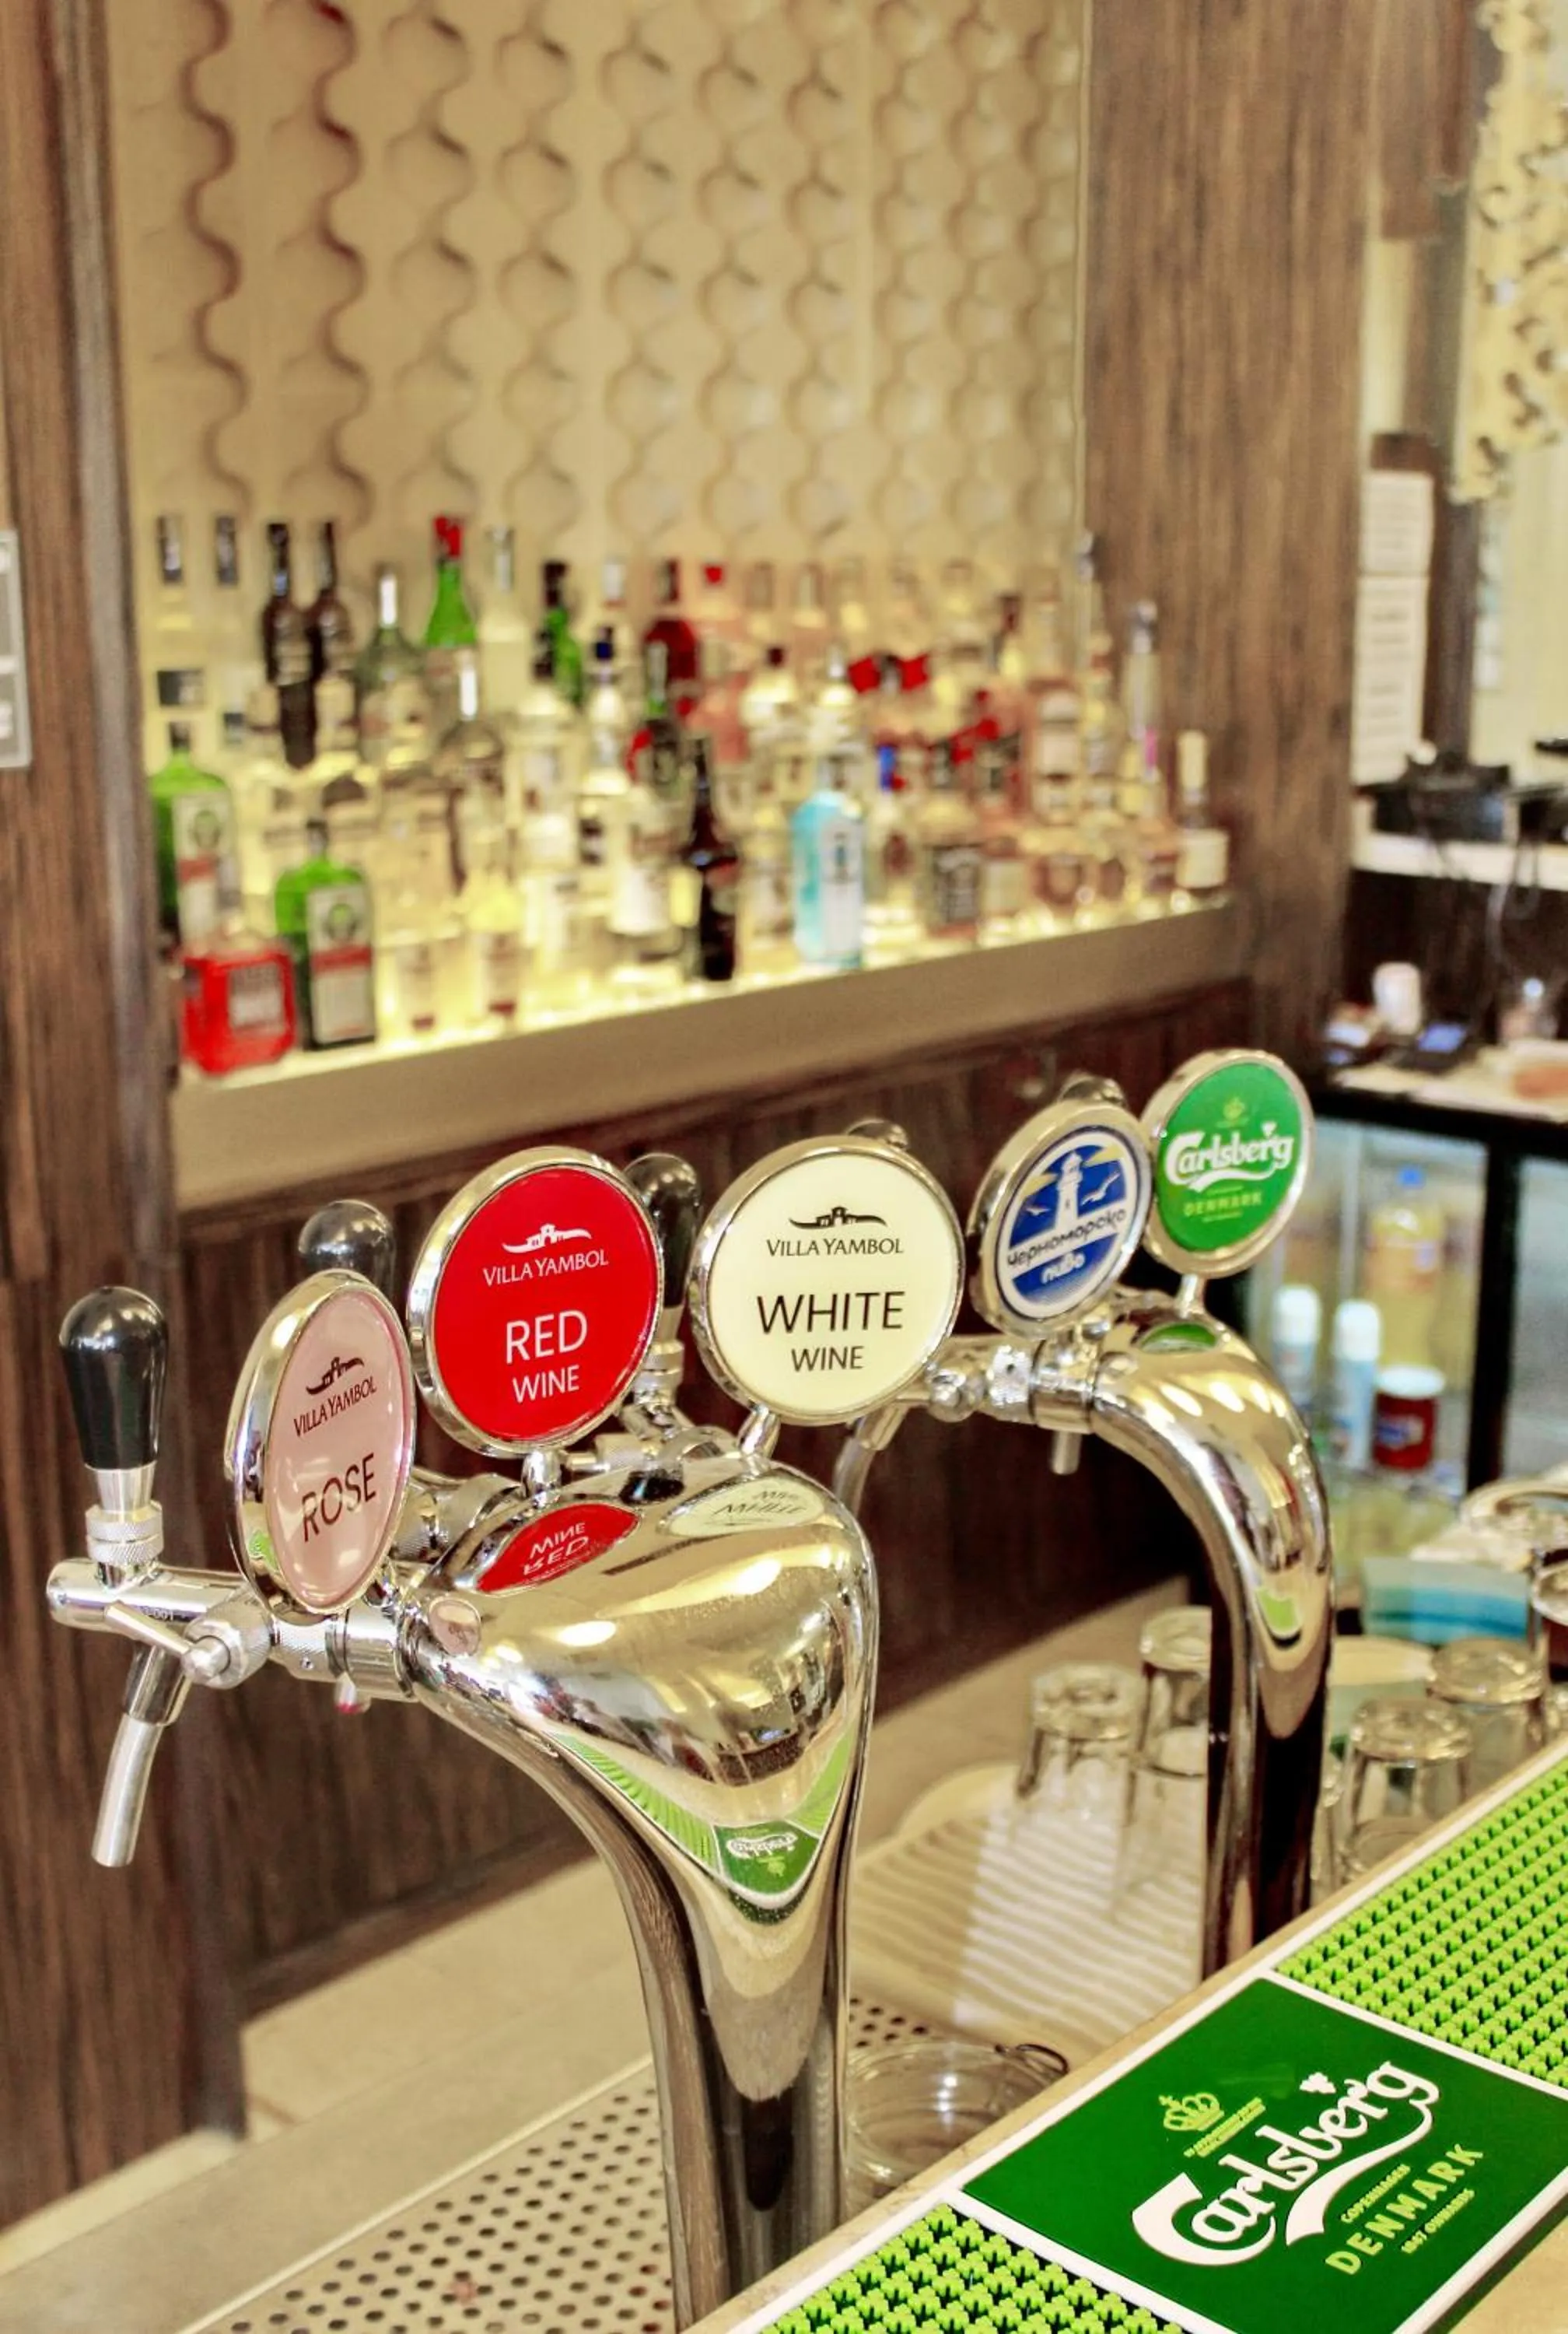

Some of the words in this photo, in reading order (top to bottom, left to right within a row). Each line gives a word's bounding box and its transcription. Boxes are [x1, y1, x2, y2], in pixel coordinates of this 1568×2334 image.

[1164, 1127, 1294, 1191] Carlsberg
[482, 1262, 534, 1287] VILLA
[535, 1249, 609, 1277] YAMBOL
[766, 1239, 820, 1256] VILLA
[823, 1238, 904, 1256] YAMBOL
[506, 1309, 588, 1365] RED
[757, 1291, 905, 1335] WHITE
[513, 1364, 579, 1404] WINE
[791, 1345, 864, 1372] WINE
[293, 1404, 328, 1437] VILLA
[327, 1376, 377, 1417] YAMBOL
[302, 1453, 376, 1542] ROSE
[1132, 2060, 1440, 2266] Carlsberg
[1325, 2143, 1484, 2275] DENMARK
